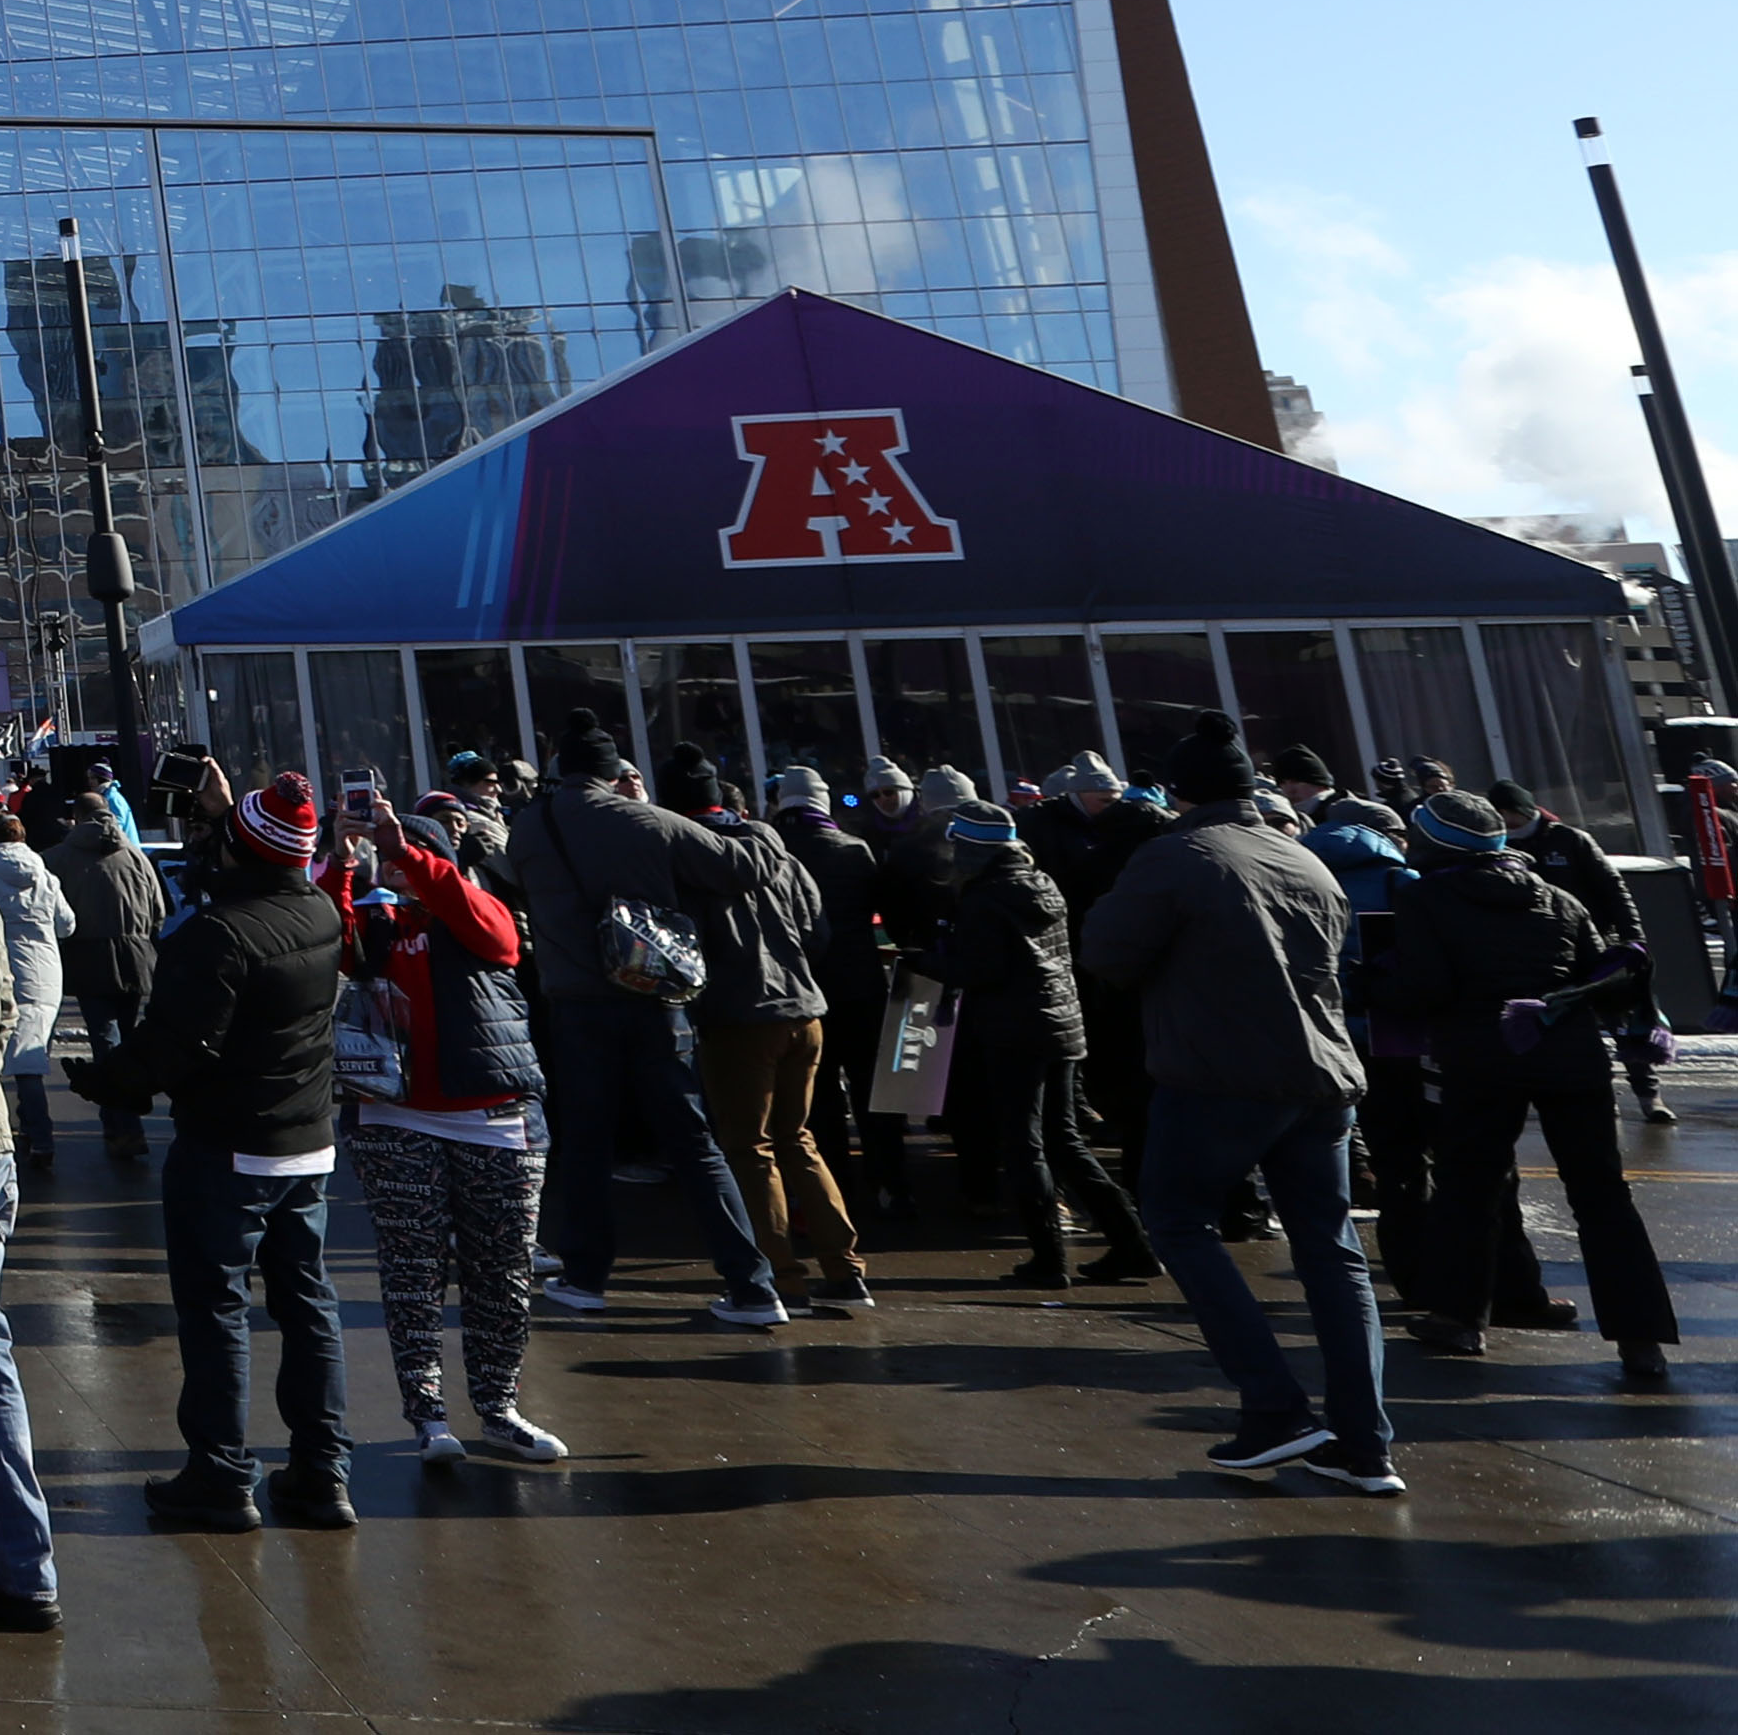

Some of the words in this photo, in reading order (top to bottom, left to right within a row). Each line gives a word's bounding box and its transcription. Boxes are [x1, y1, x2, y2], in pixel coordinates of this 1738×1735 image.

[340, 1060, 378, 1073] SERVICE
[376, 1178, 431, 1196] PATRIOTS
[386, 1291, 433, 1303] PATRIOTS
